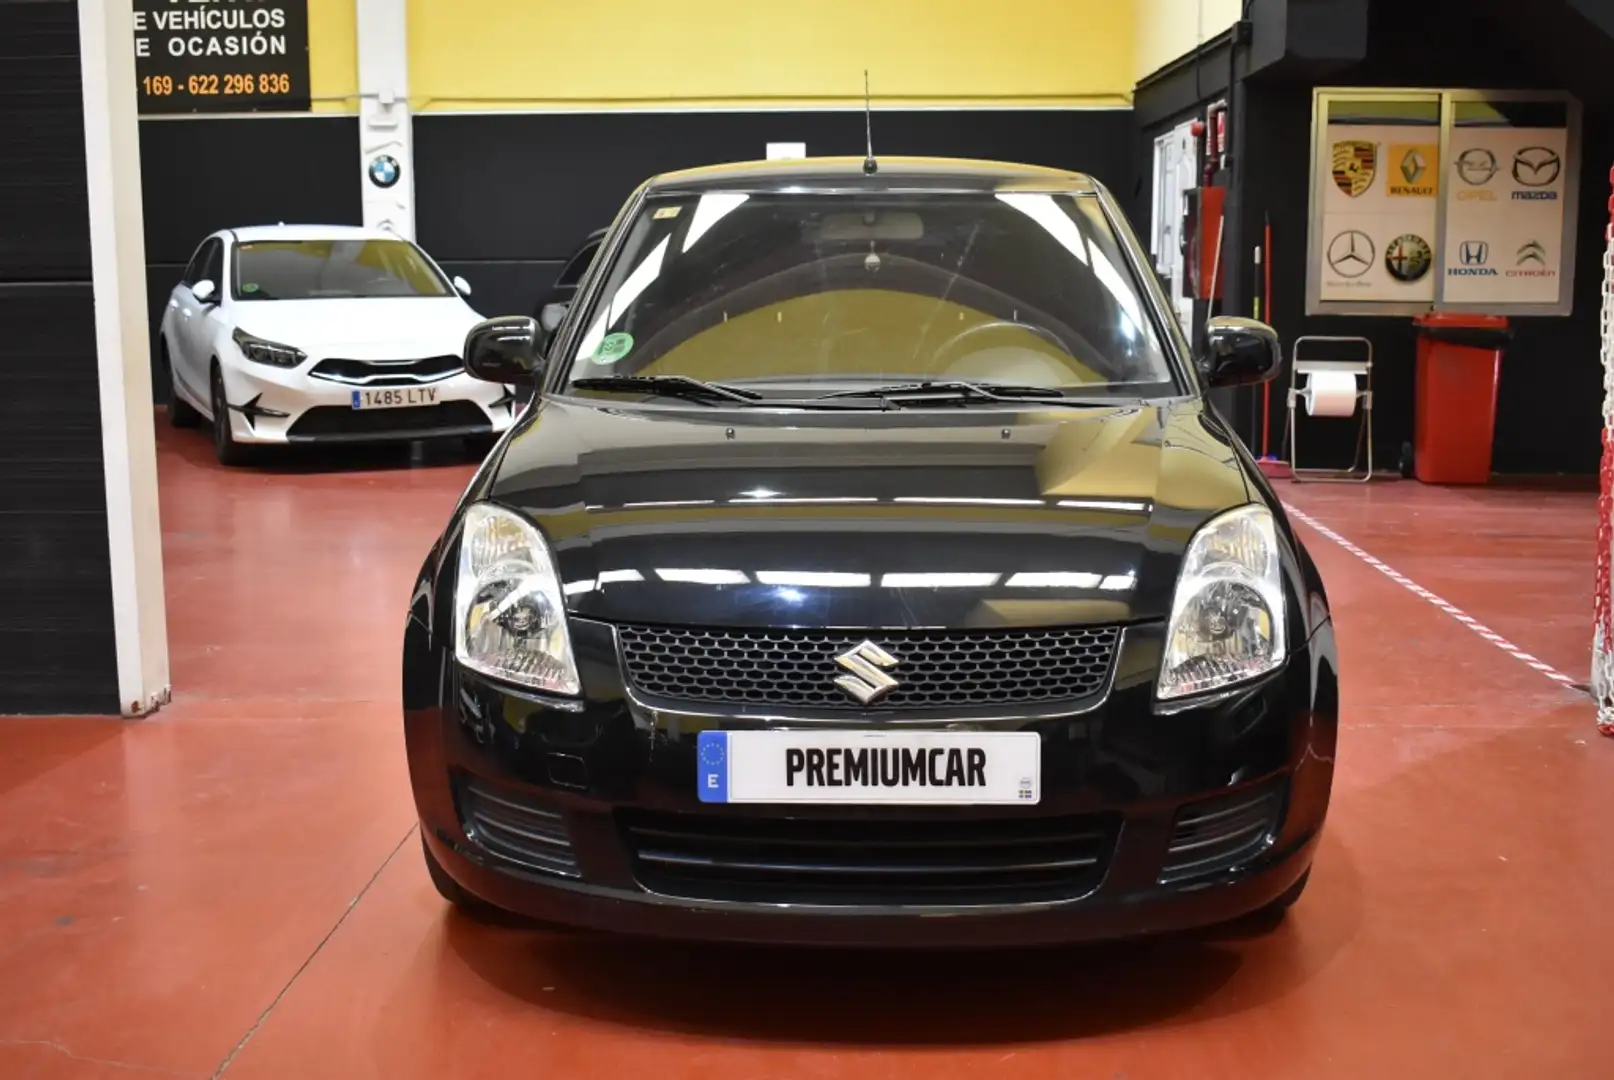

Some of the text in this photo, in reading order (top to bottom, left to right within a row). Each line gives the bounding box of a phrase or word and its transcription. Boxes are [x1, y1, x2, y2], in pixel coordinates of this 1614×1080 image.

[152, 5, 286, 30] VEHÍCULOS
[168, 30, 286, 57] OCASIÓN
[143, 75, 172, 95] 169
[188, 74, 219, 95] 622
[224, 73, 254, 94] 296
[259, 73, 290, 94] 836
[1390, 186, 1433, 195] RENAULT
[1448, 268, 1498, 276] HONDA
[365, 391, 402, 405] 1485
[407, 388, 436, 404] LTV
[786, 747, 987, 787] PREMIUMCAR
[708, 774, 719, 788] E
